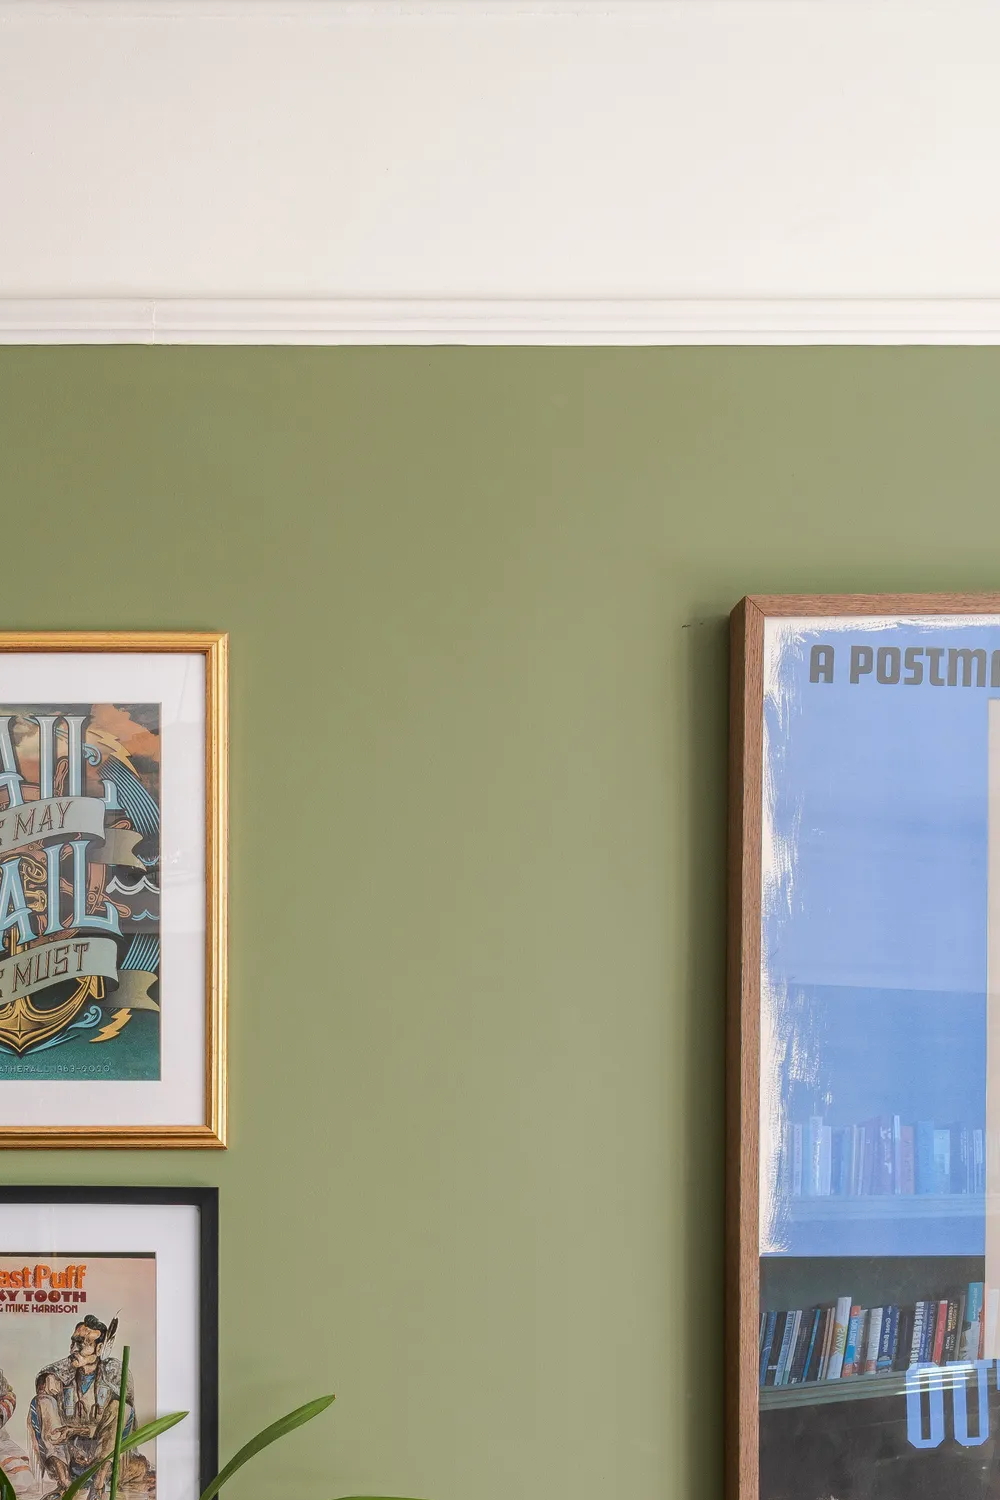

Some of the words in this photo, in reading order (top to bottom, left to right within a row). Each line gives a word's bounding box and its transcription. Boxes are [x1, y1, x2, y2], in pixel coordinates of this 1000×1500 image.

[809, 644, 835, 683] A
[12, 800, 74, 843] MAY
[11, 942, 91, 993] MUST
[33, 1264, 88, 1289] Puff
[5, 1304, 30, 1314] MIKE
[31, 1304, 79, 1314] HARRISON
[23, 1290, 87, 1303] TOOTH
[905, 1358, 1000, 1449] OU
